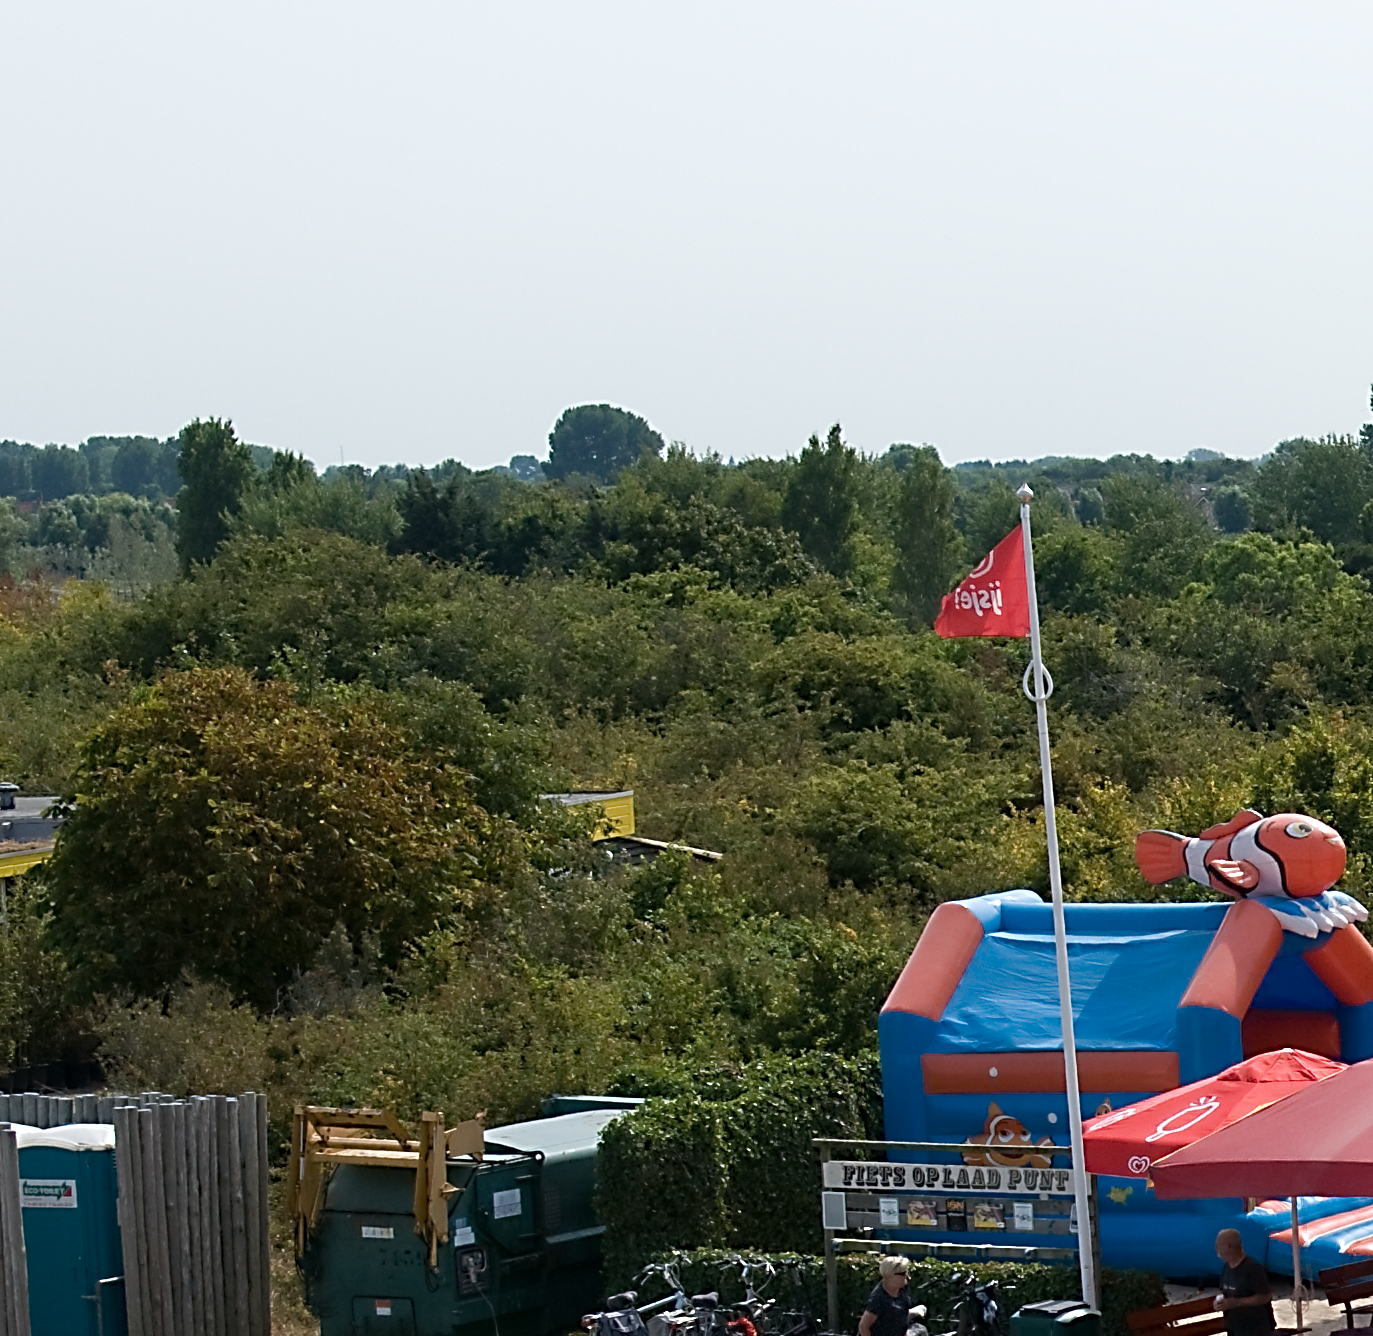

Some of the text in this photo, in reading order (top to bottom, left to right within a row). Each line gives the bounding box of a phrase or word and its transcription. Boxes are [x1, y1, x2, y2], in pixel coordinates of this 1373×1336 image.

[842, 1165, 1069, 1191] FIETS OPLAAD PUNT
